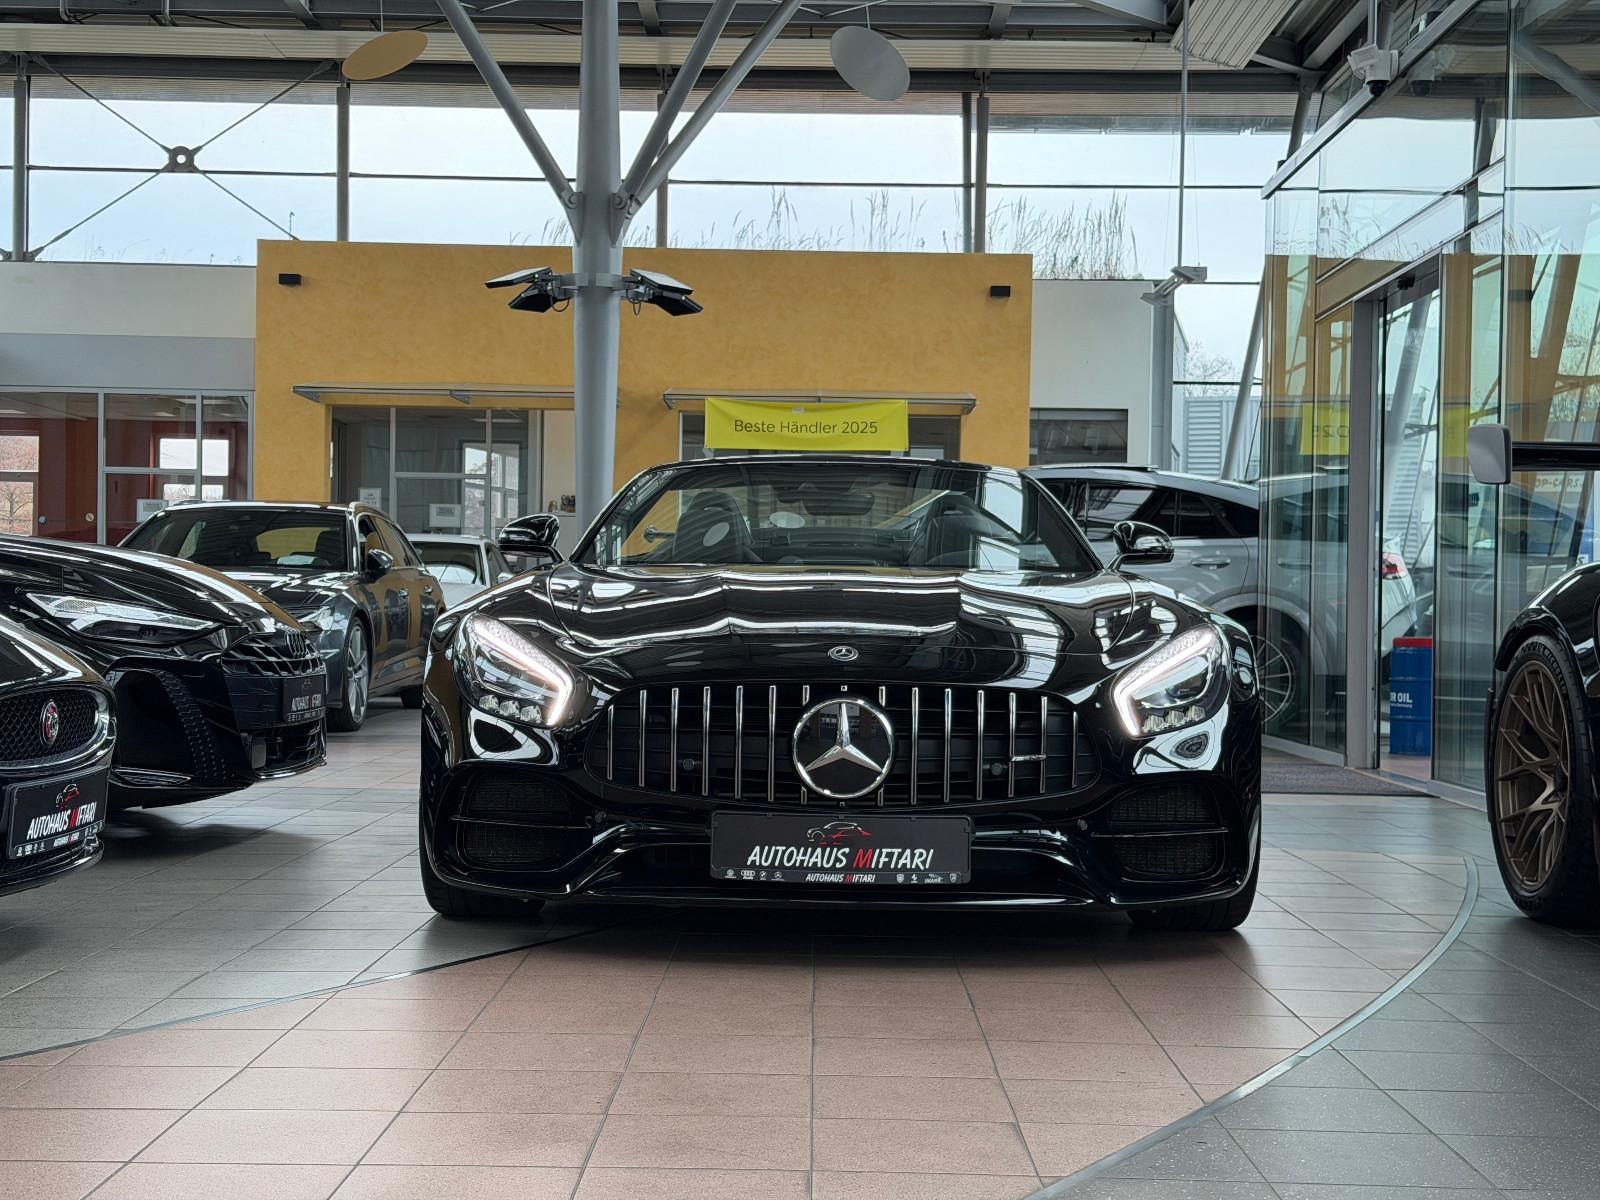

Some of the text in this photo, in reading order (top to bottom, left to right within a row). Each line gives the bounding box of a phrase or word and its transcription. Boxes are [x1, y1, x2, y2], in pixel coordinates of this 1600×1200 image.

[734, 419, 878, 434] Beste Händler 2025
[1397, 692, 1413, 703] OIL
[26, 810, 71, 840] AUTOHAUS
[70, 801, 97, 828] MIFTARI
[746, 846, 934, 870] AUTOHAUS MIFTARI
[805, 873, 876, 884] AUTOHAUS MIFTARI
